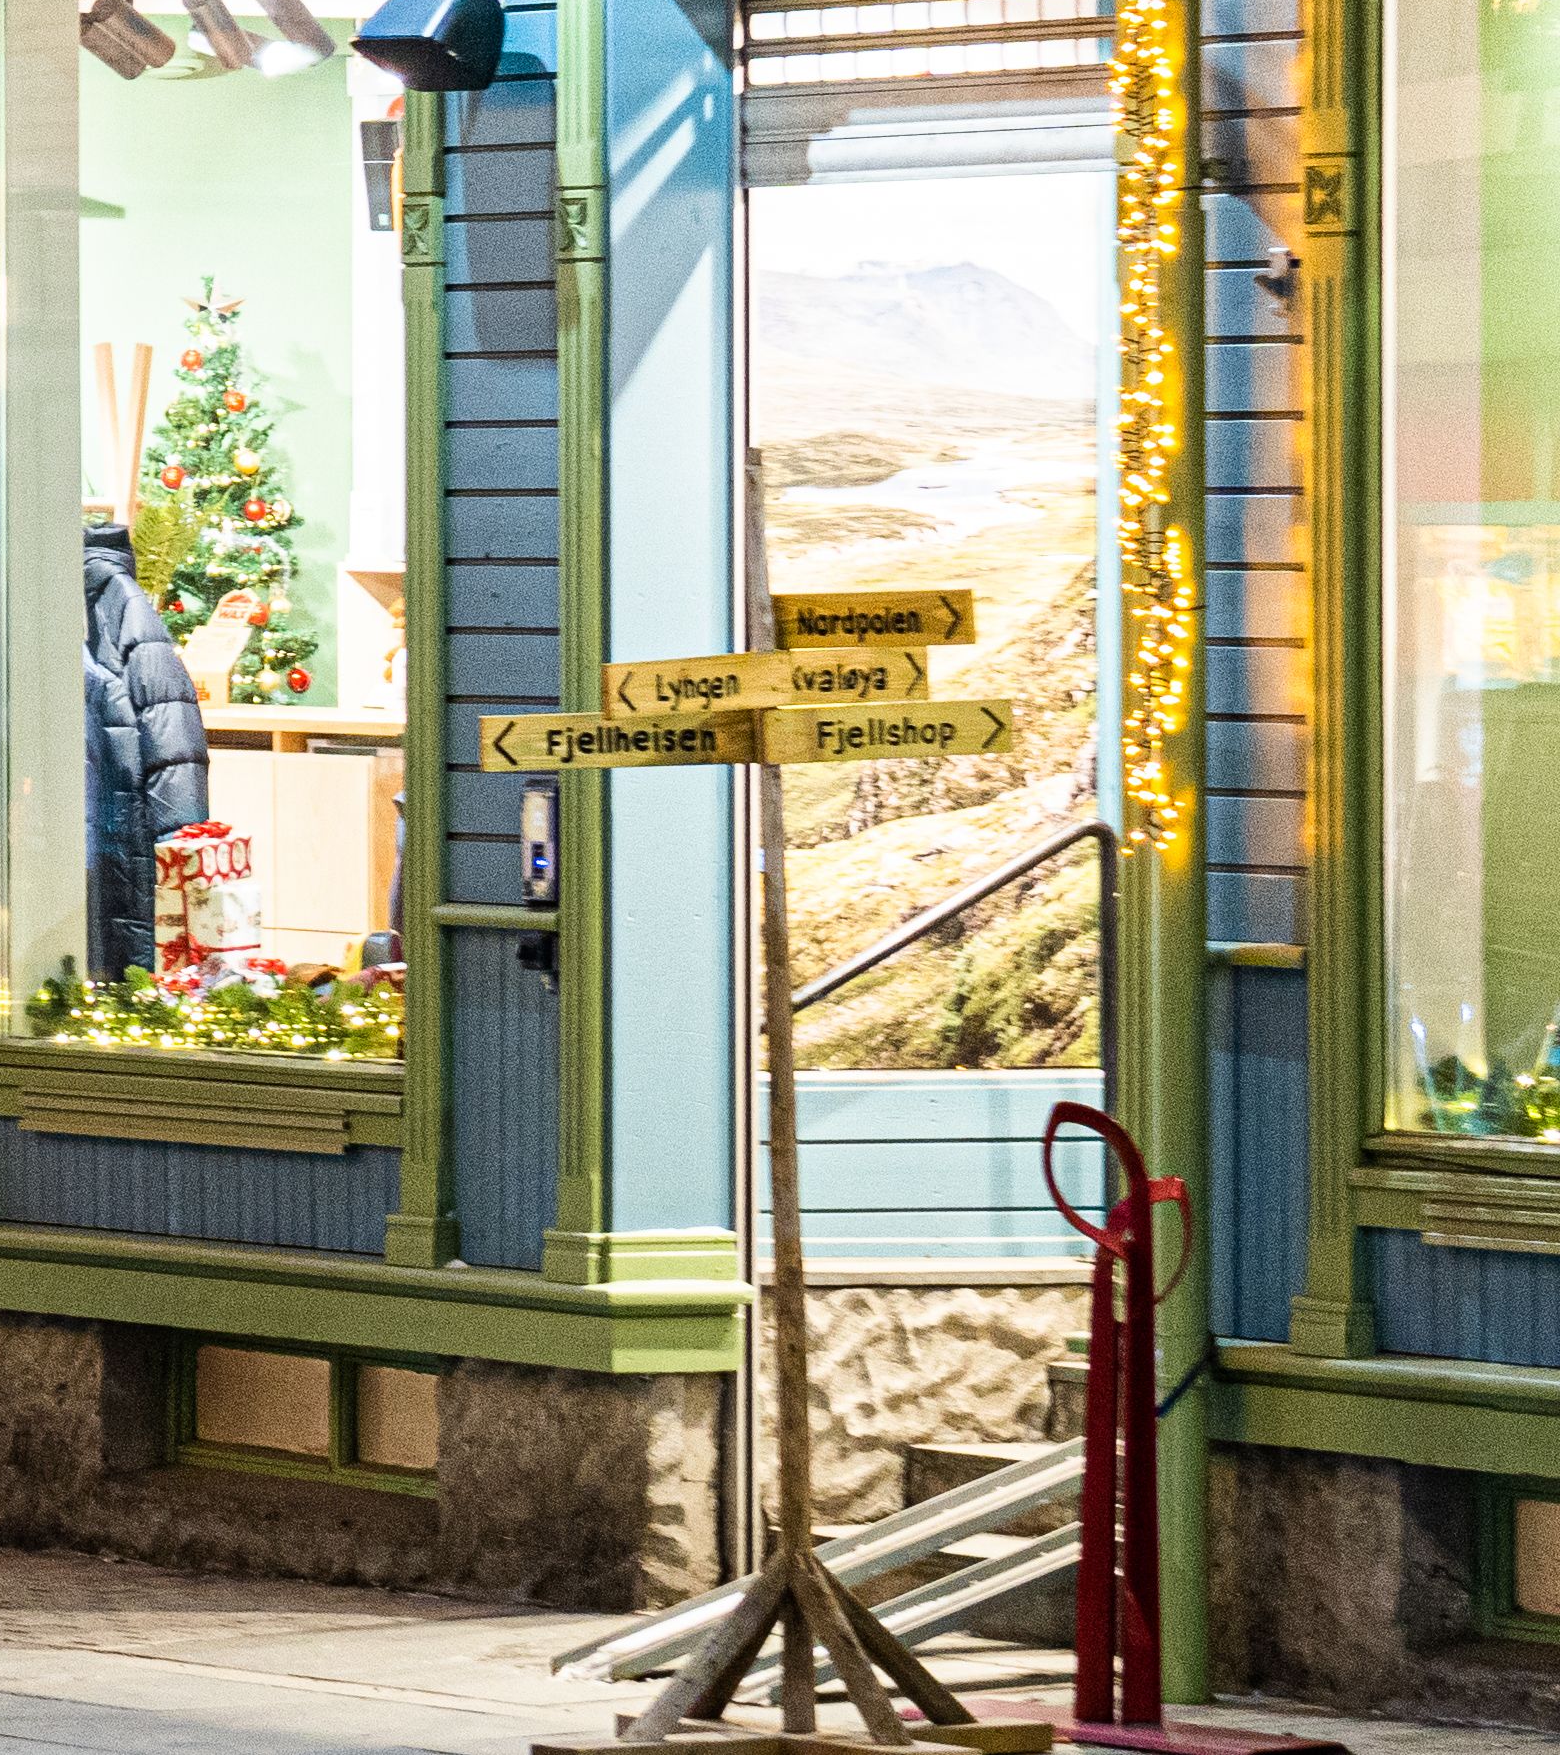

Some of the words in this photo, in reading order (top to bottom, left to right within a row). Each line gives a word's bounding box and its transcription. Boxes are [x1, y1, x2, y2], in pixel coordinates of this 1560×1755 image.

[797, 607, 922, 643] Nordpolen
[655, 672, 739, 711] Lyngen
[546, 722, 716, 763] Fjellheisen
[817, 717, 958, 755] Fjellshop
